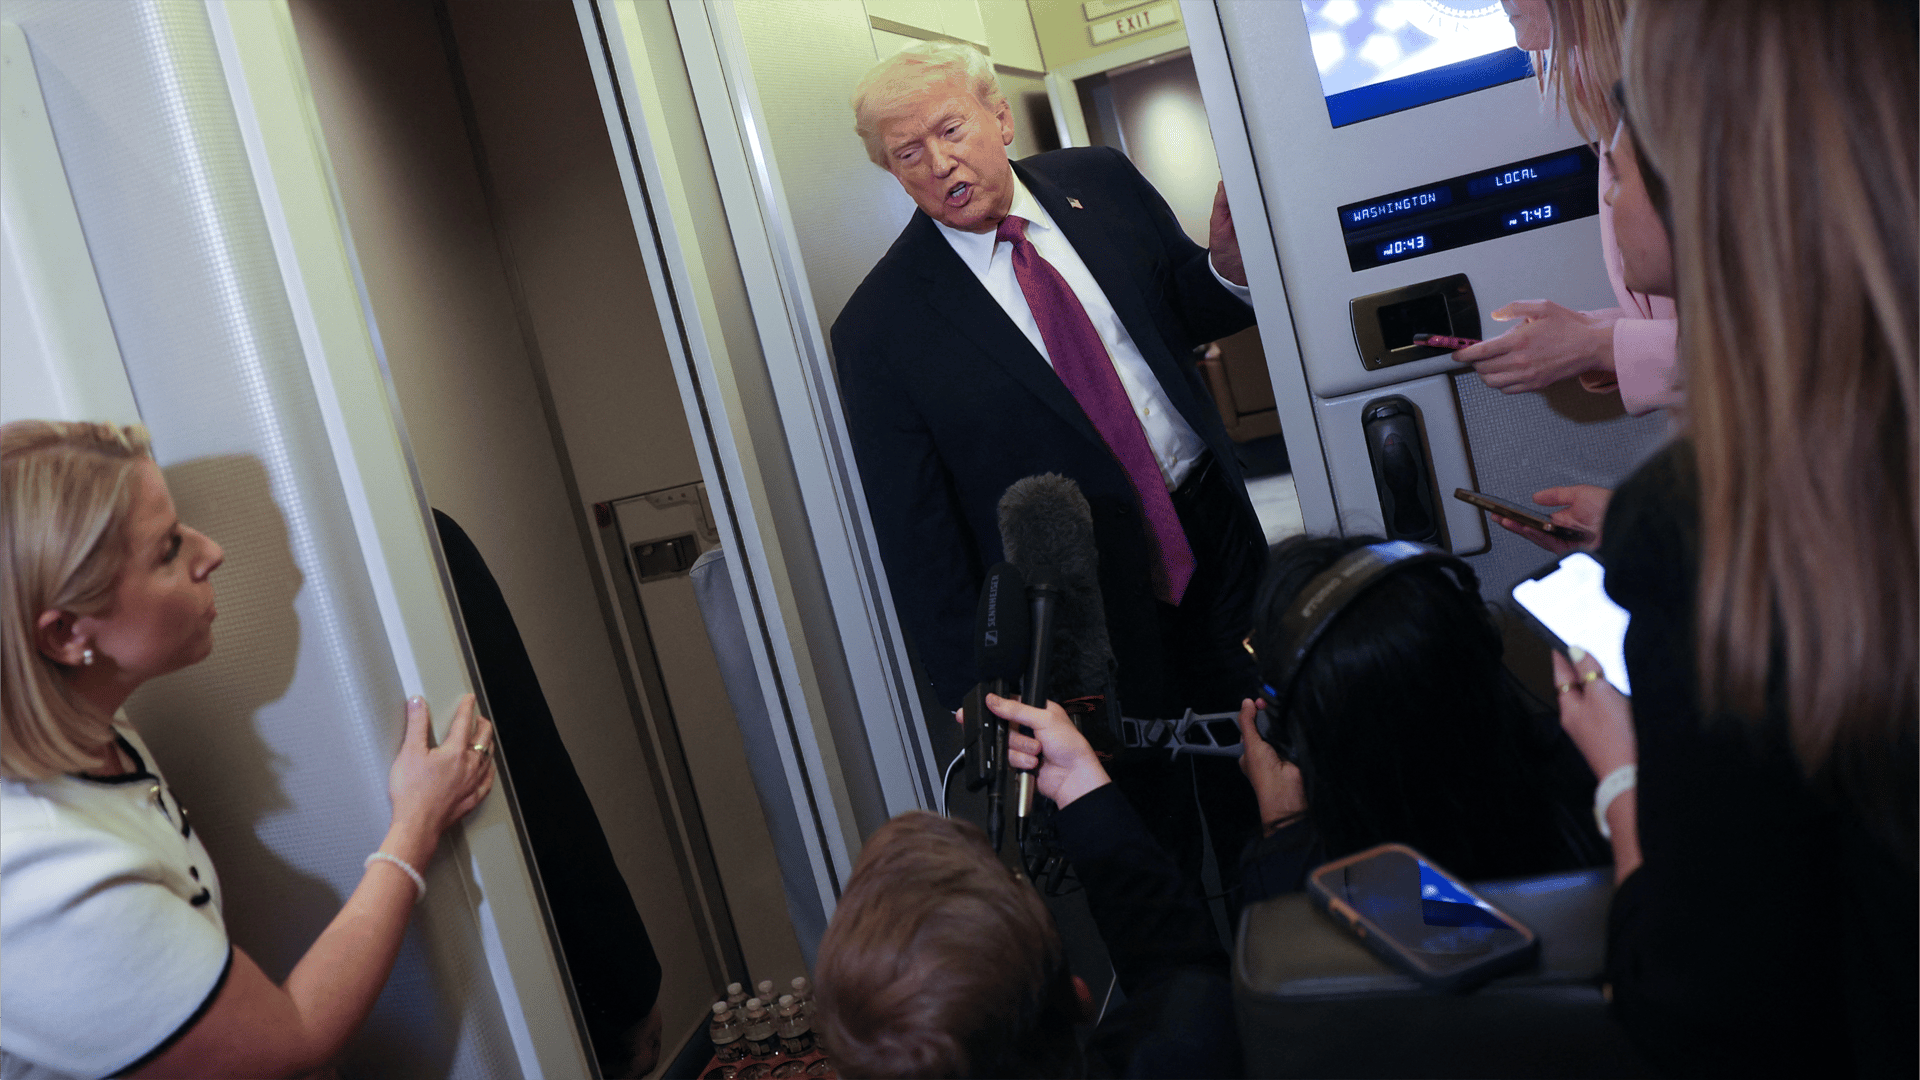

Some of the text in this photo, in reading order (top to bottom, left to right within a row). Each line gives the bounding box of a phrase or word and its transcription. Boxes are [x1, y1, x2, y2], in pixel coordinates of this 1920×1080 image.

[1116, 11, 1150, 33] EXIT
[1495, 168, 1538, 187] LOCAL
[1353, 192, 1436, 222] WASHINGTON
[1520, 205, 1552, 222] 7:43
[1389, 235, 1424, 255] 10:43
[987, 574, 999, 627] SENNHEISER
